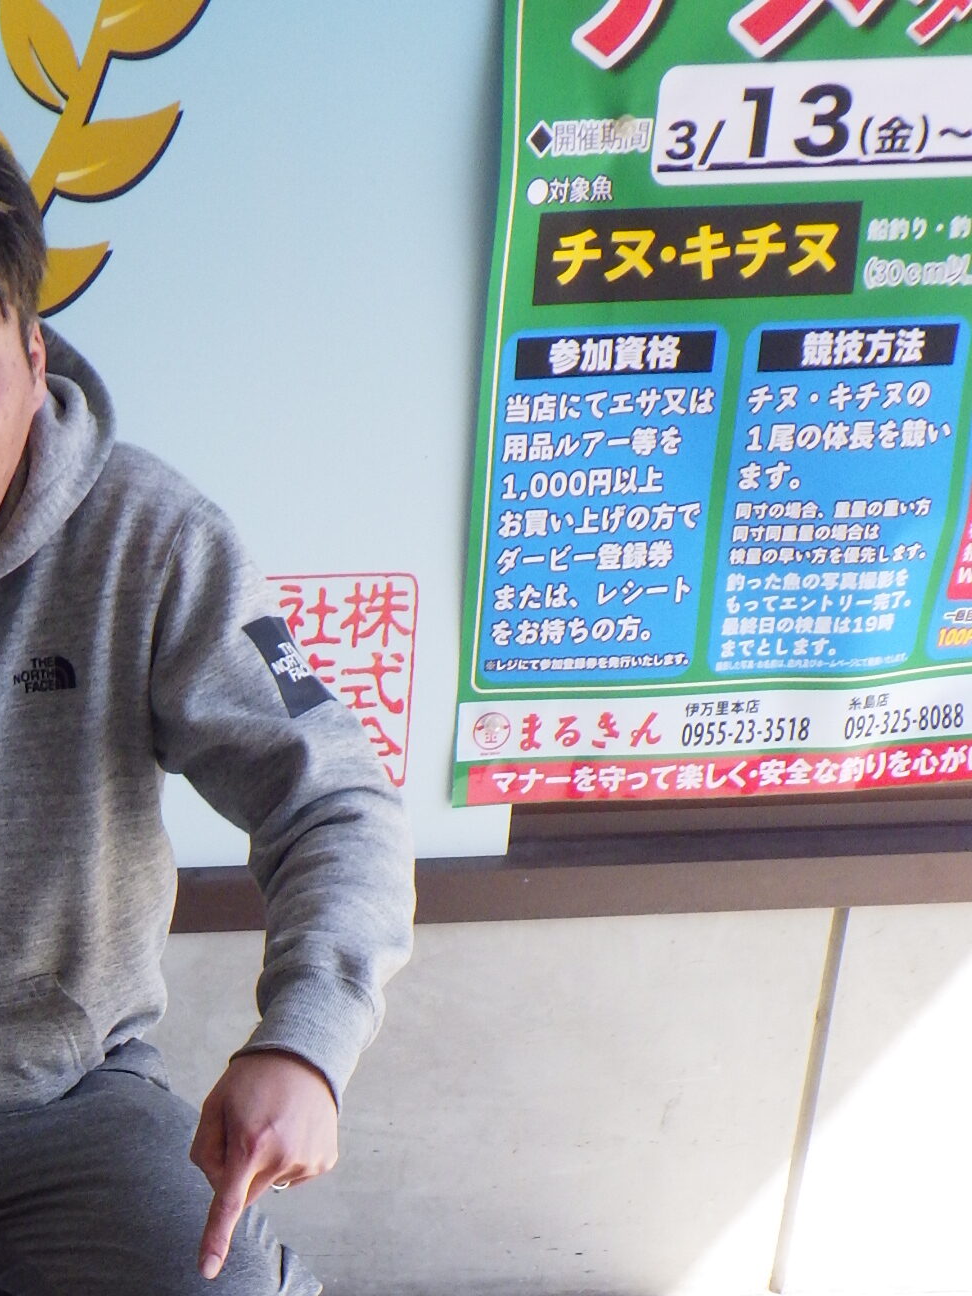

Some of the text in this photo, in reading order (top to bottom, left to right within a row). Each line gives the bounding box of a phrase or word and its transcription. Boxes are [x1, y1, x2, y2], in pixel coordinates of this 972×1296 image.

[552, 118, 653, 155] 開催期間
[547, 176, 613, 204] 対象魚
[552, 221, 840, 285] チヌ・キチヌ
[864, 253, 972, 289] (30cm以
[549, 335, 681, 375] 参加資格
[802, 329, 926, 366] 競技方法
[505, 387, 715, 423] 当店にてエサ又は
[748, 381, 931, 413] チヌ・キチヌの
[501, 426, 682, 462] 用品ルアー等を
[746, 419, 952, 452] 1尾の体長を競い
[501, 466, 663, 500] 1,000円以上
[738, 461, 801, 490] ます。
[497, 502, 701, 537] お買い上げの方で
[497, 539, 673, 574] ダービー登録券
[491, 615, 651, 645] をお持ちの方。
[31, 656, 54, 668] THE
[720, 637, 837, 658] までとします。
[13, 668, 54, 685] NORTH
[25, 680, 54, 693] FACE
[685, 699, 760, 717] 伊万里本店
[848, 693, 890, 711] 糸島店
[519, 713, 662, 751] まるきん
[681, 717, 810, 747] 0955-23-3518
[844, 703, 964, 741] 092-325-8088
